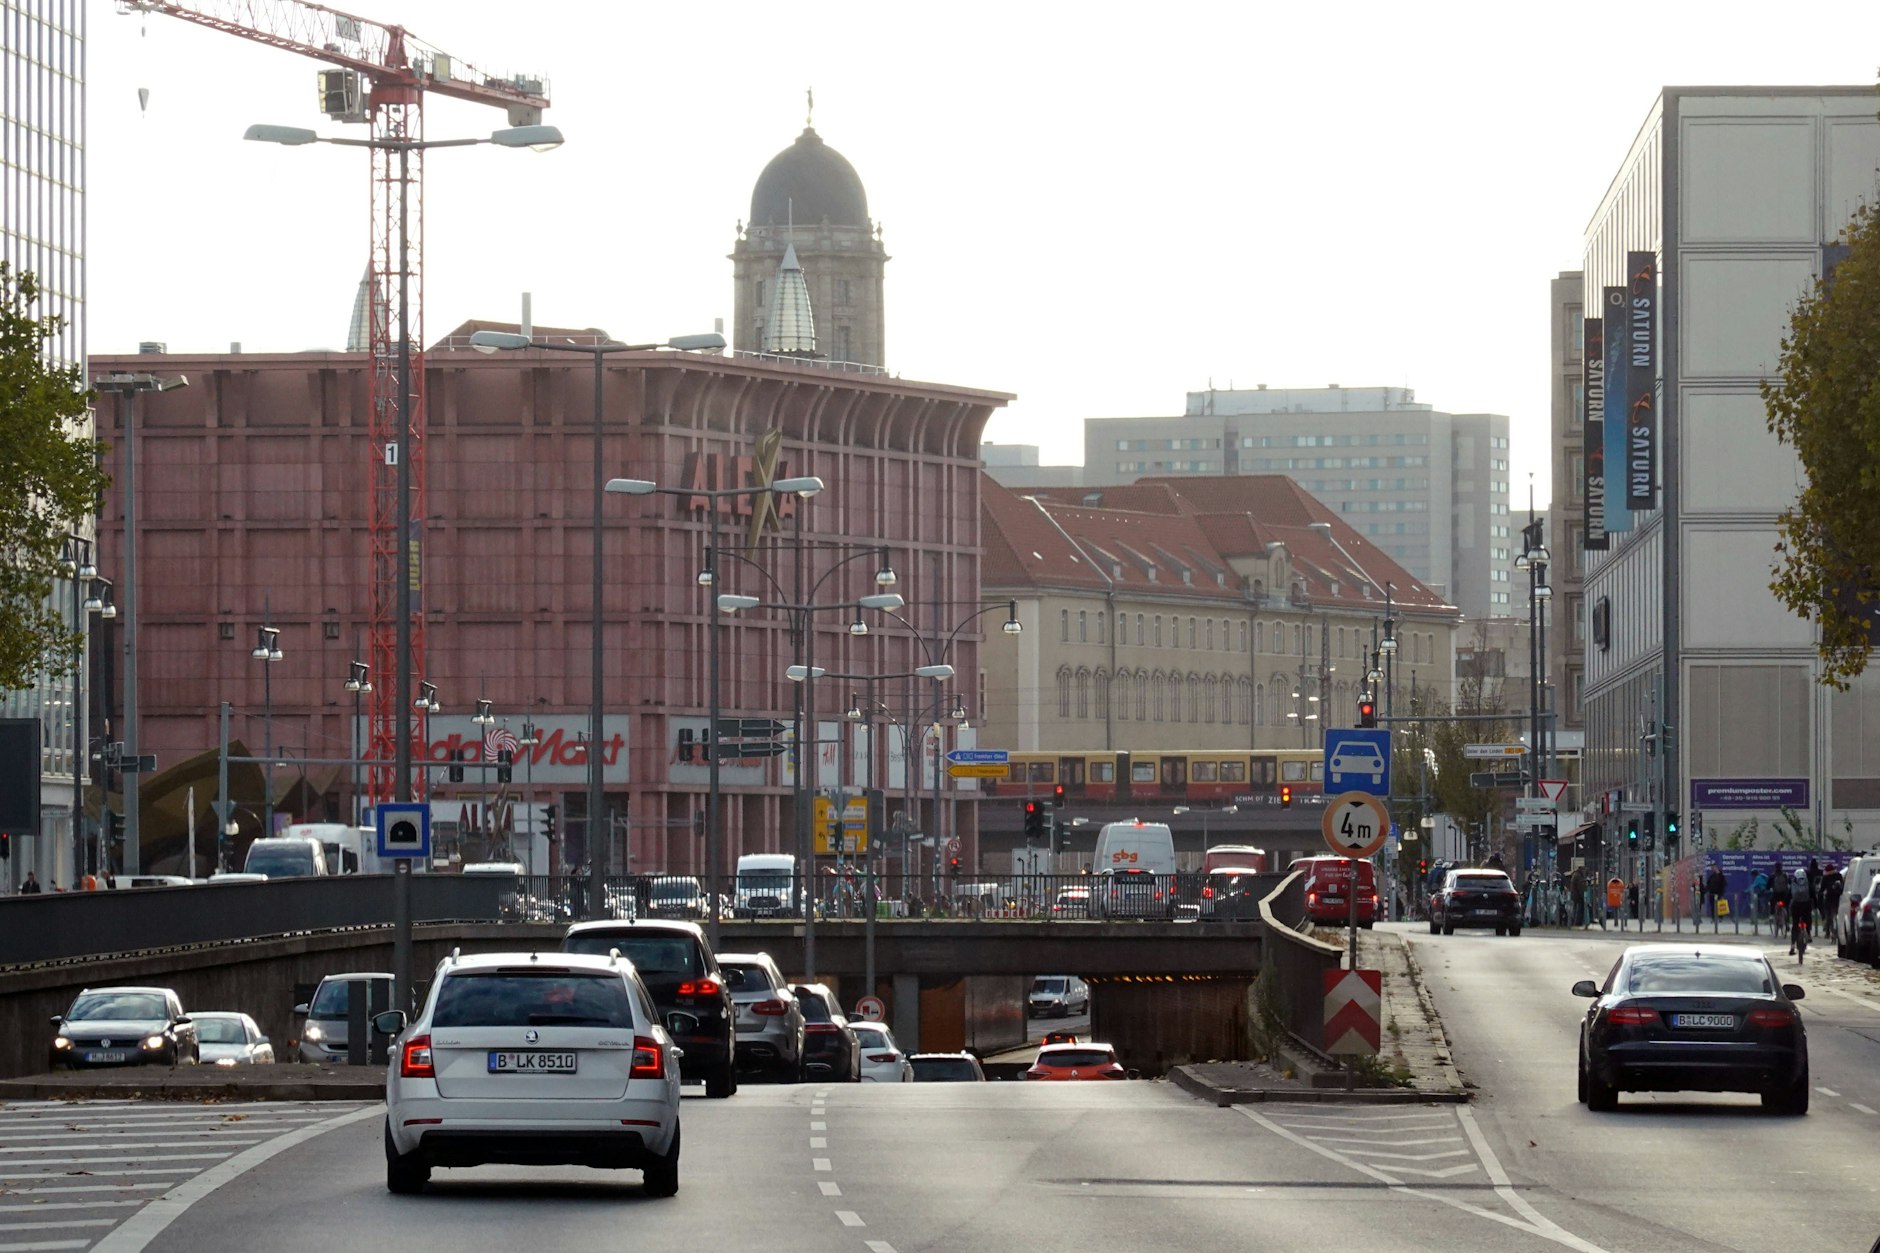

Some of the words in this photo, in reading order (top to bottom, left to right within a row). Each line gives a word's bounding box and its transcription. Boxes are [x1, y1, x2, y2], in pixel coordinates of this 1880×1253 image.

[1633, 298, 1650, 367] SATURN
[1588, 359, 1604, 422] SATURN
[387, 445, 395, 463] 1
[1632, 426, 1650, 497] SATURN
[680, 432, 797, 548] ALEXA
[1588, 476, 1605, 539] SATURN
[361, 733, 483, 763] dia
[1707, 787, 1793, 795] premiumposter.com
[1341, 812, 1354, 838] 4
[1358, 825, 1371, 838] m
[1112, 848, 1138, 864] sbg
[1679, 1015, 1686, 1025] B
[1692, 1016, 1706, 1026] LC
[1707, 1016, 1733, 1026] 9000
[498, 1054, 507, 1068] B
[516, 1054, 535, 1068] LK
[538, 1054, 573, 1068] 8510
